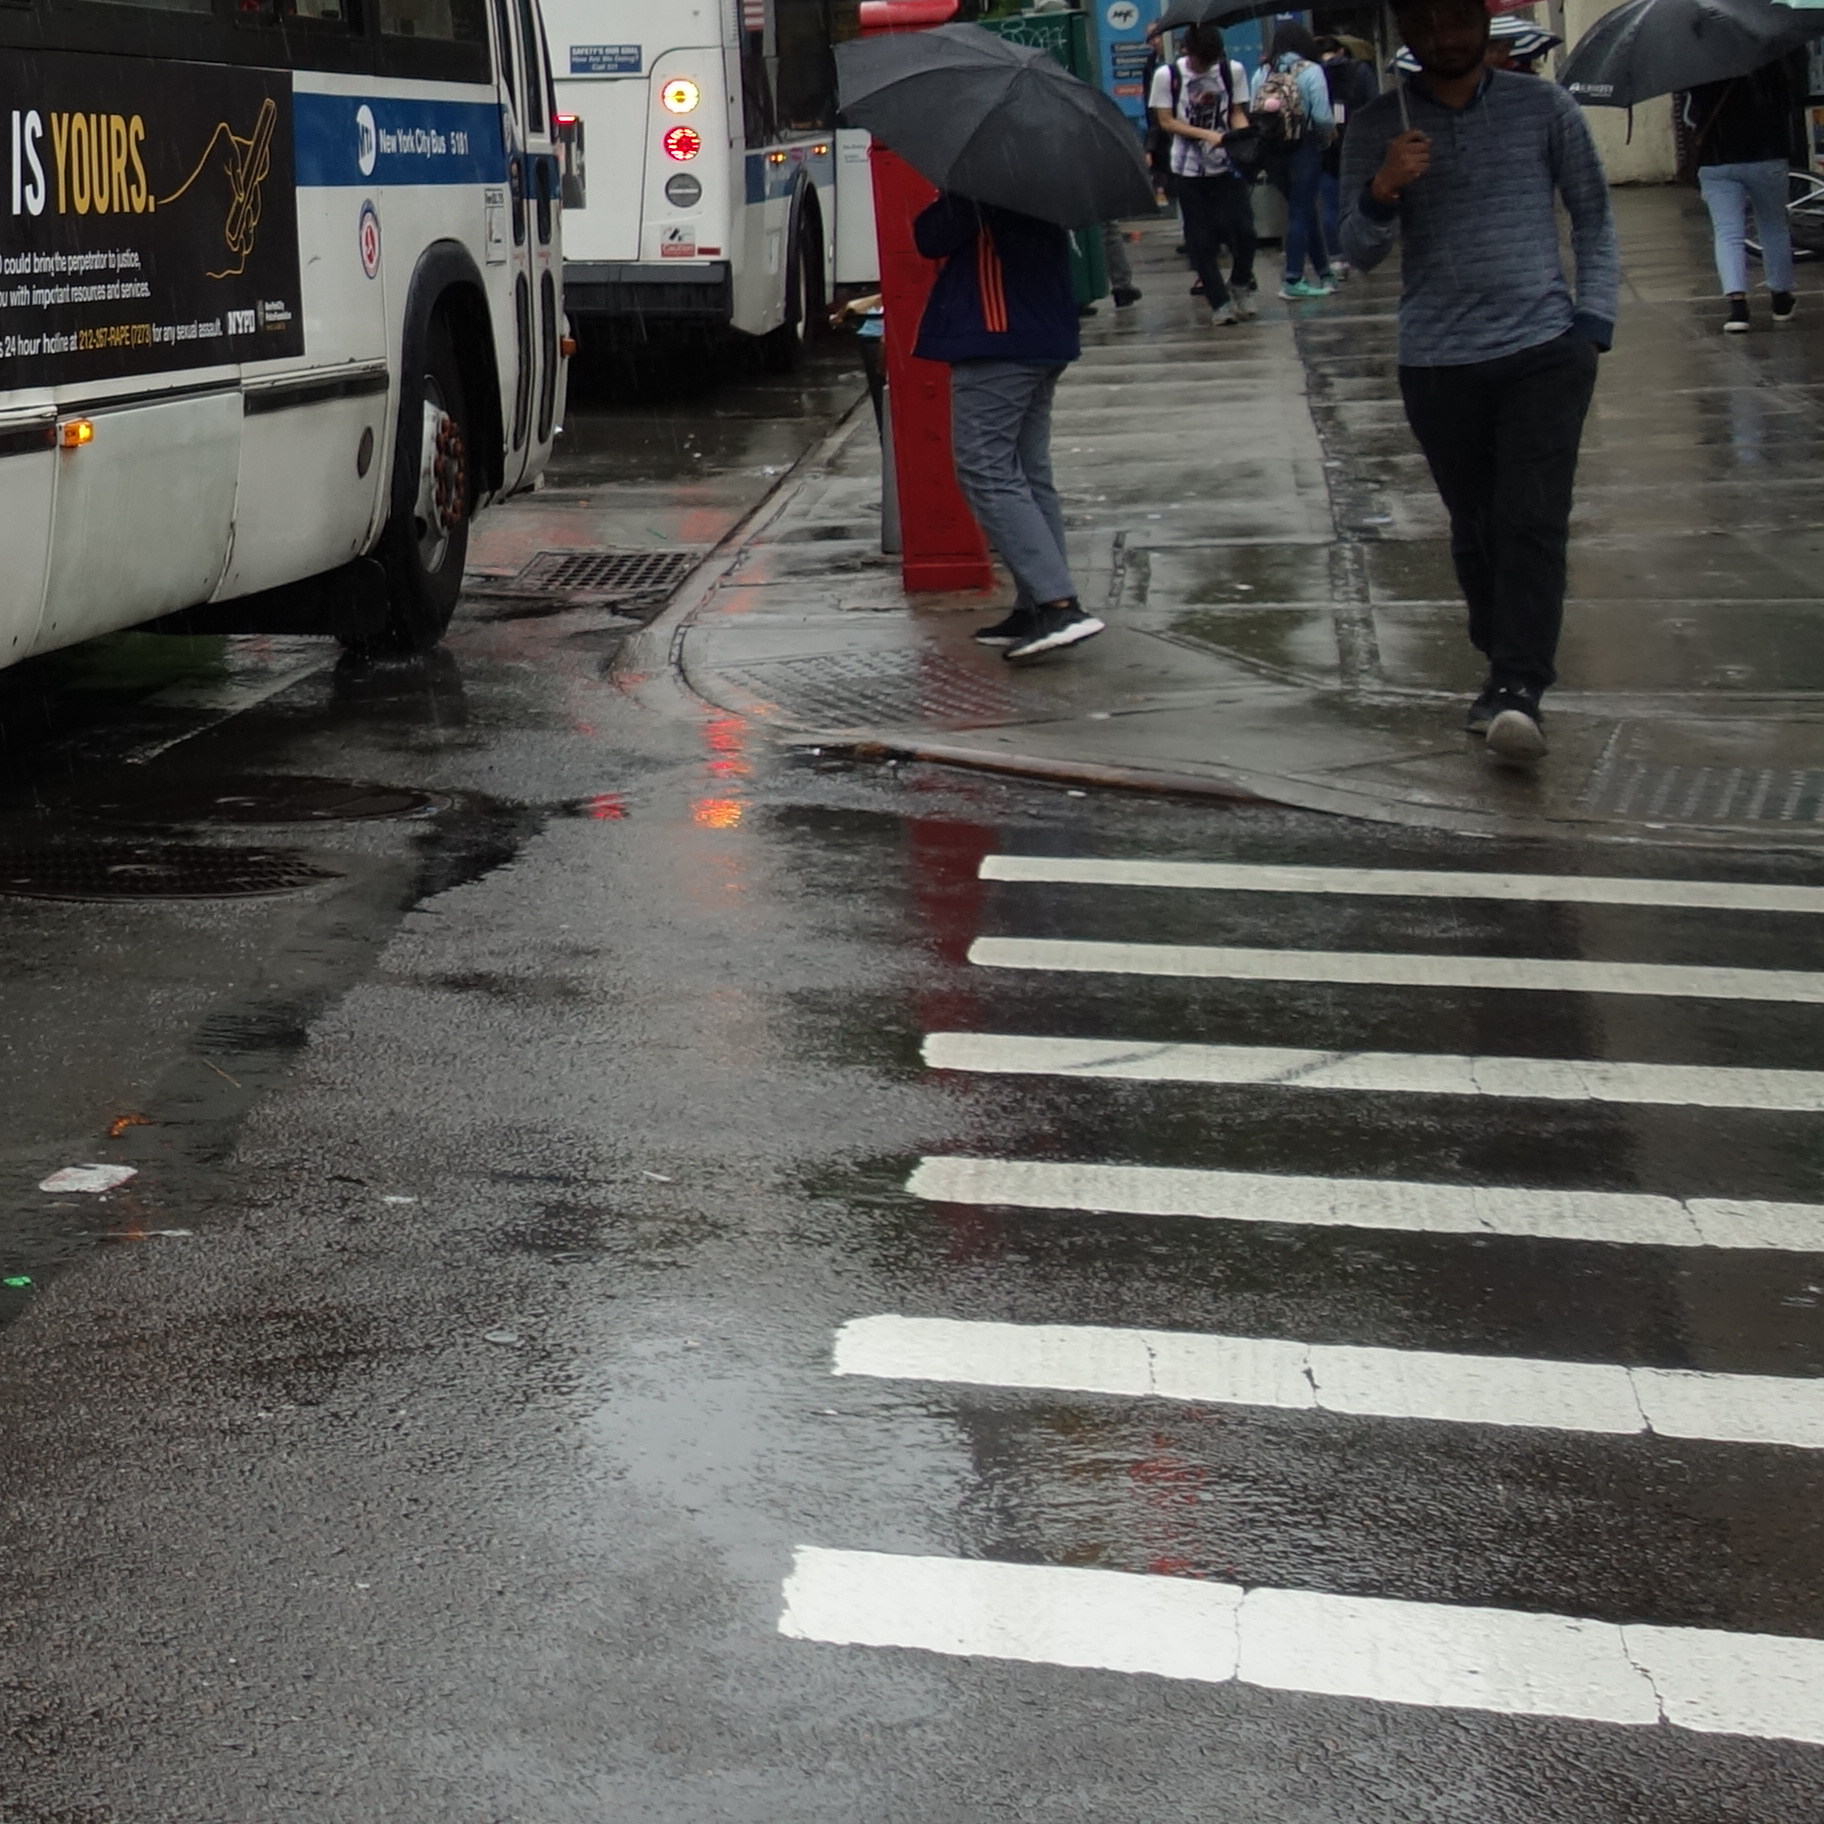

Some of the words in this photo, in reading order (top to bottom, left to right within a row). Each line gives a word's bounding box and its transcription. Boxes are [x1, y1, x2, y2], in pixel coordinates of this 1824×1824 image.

[379, 129, 397, 154] New
[397, 129, 416, 154] York
[415, 128, 431, 159] City
[431, 129, 447, 155] Bus
[451, 130, 469, 156] 5181
[11, 109, 45, 216] IS
[51, 112, 156, 214] YOURS.
[4, 252, 31, 275] could
[54, 251, 66, 272] the
[108, 249, 116, 269] to
[116, 248, 142, 273] justice,
[9, 284, 30, 307] with
[71, 284, 105, 304] resources
[107, 279, 121, 301] and
[121, 278, 151, 300] services.
[4, 335, 16, 358] 24
[17, 333, 42, 356] hour
[69, 330, 78, 351] at
[152, 323, 162, 342] for
[163, 326, 176, 346] any
[177, 320, 198, 343] sexual
[227, 309, 256, 335] NYPD
